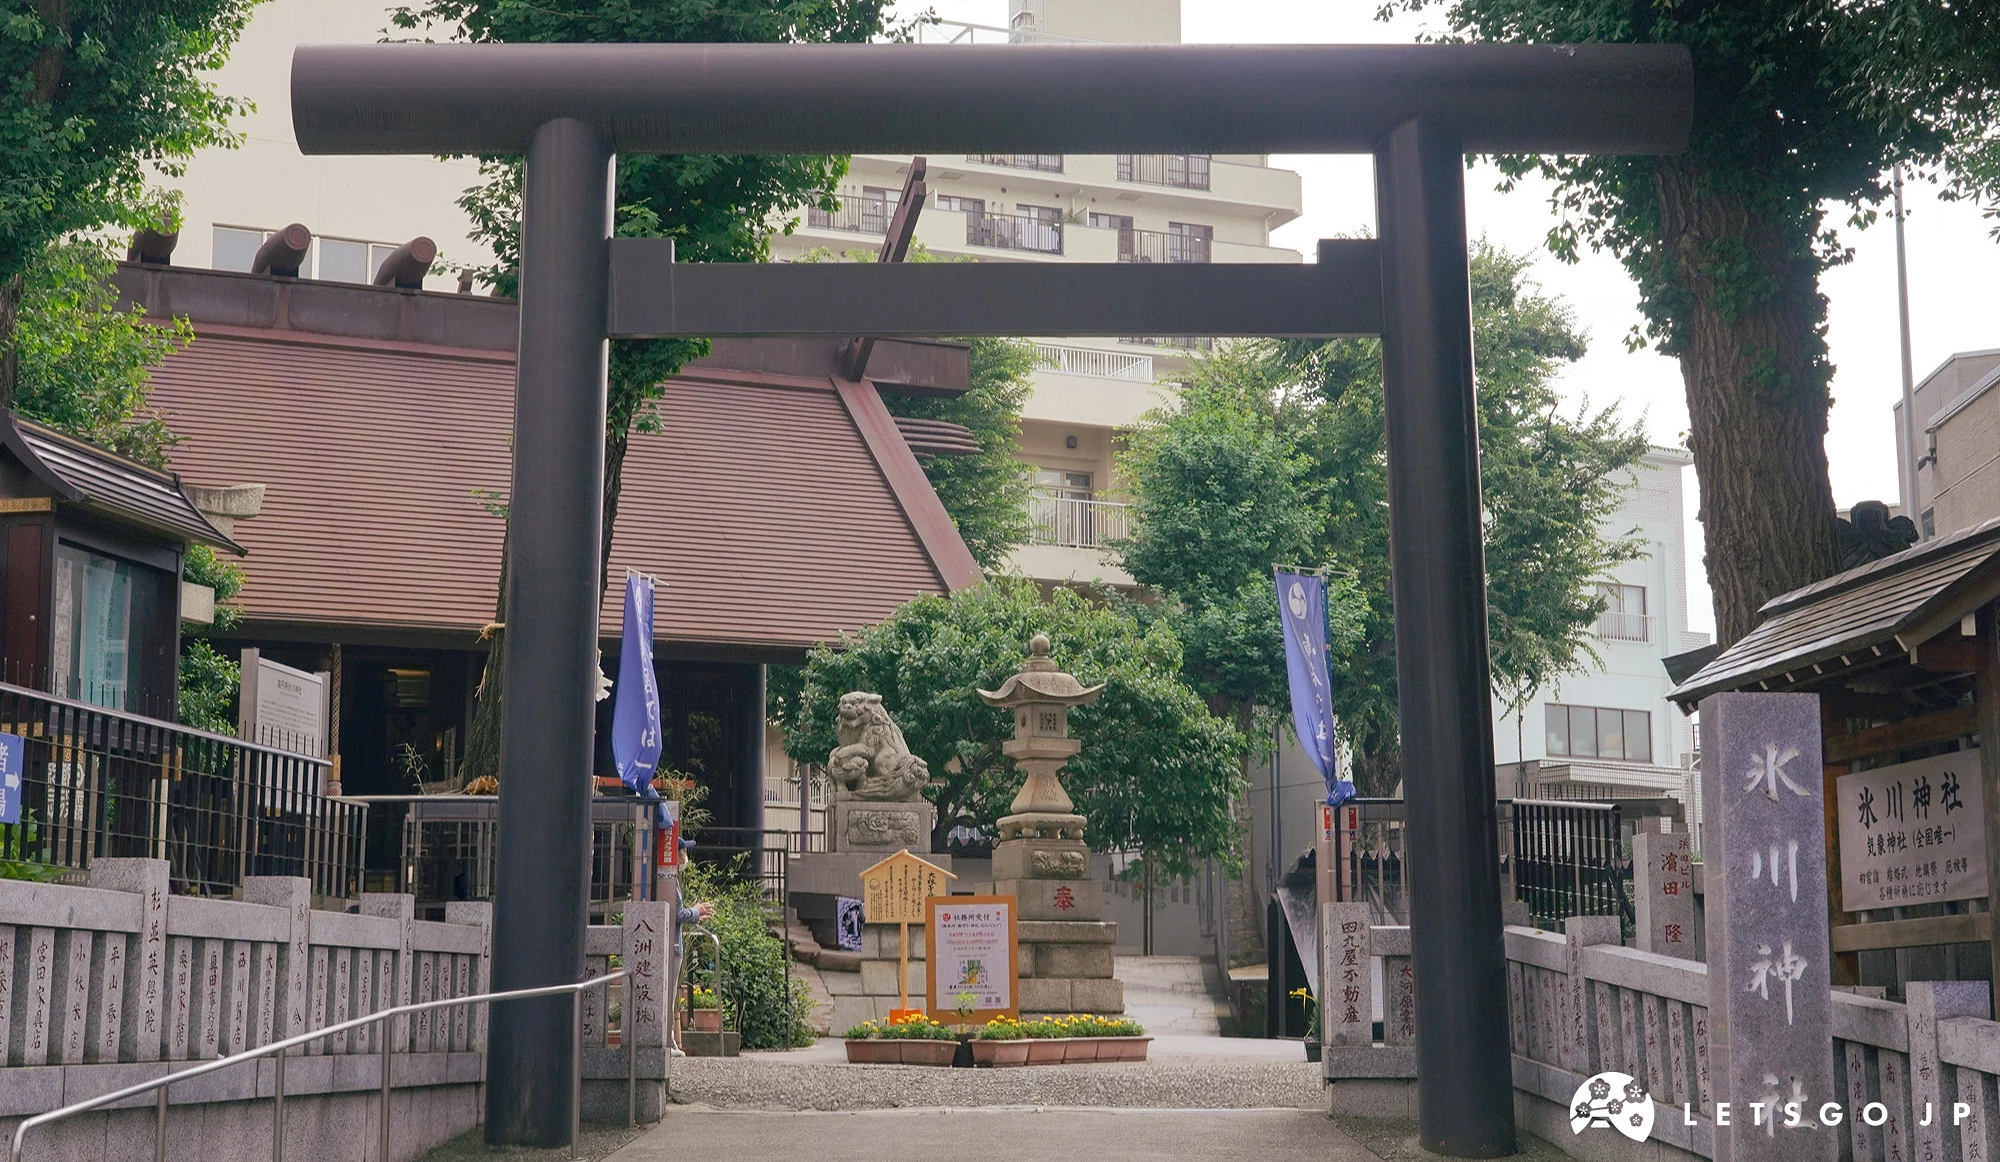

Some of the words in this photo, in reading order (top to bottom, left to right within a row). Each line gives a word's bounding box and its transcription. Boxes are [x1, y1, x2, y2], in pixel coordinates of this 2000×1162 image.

[1858, 771, 1963, 830] 氷川神社
[1866, 831, 1908, 857] 気象神社
[1912, 823, 1956, 849] (全国唯一)
[1679, 838, 1693, 889] 浜田ビル
[1886, 865, 1908, 882] 結婚式
[1915, 861, 1938, 878] 地鎮祭
[954, 912, 990, 922] 社務所受付
[1053, 886, 1075, 911] 奉
[1739, 742, 1819, 1138] 氷川神社
[633, 919, 656, 1022] 八洲建設株)
